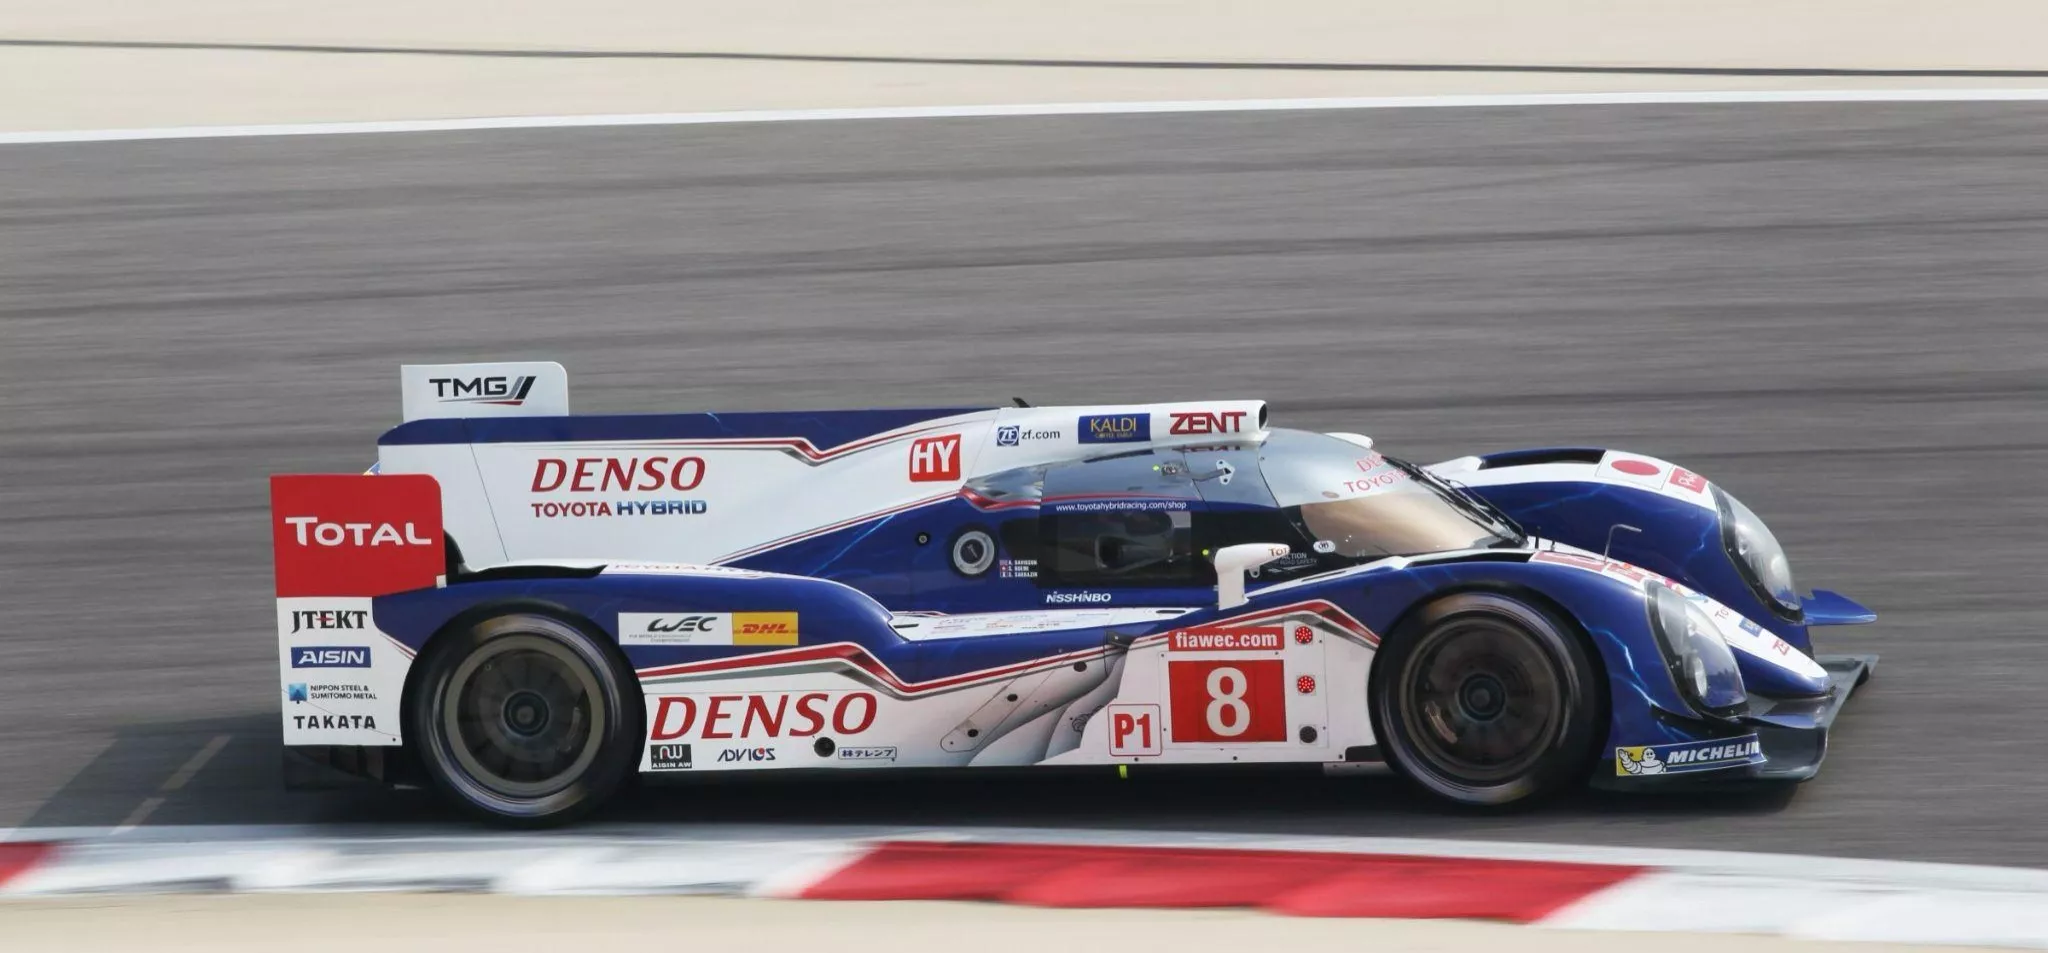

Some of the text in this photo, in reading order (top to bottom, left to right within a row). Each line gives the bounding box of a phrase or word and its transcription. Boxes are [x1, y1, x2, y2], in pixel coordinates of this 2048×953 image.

[428, 376, 508, 397] TMG
[1090, 417, 1137, 433] KALDI
[1169, 411, 1247, 435] ZENT
[1000, 429, 1018, 441] ZF
[1021, 429, 1061, 440] zf.com
[911, 439, 958, 473] HY
[531, 456, 707, 493] DENSO
[531, 499, 707, 518] TOYOTA HYBRID
[1056, 501, 1187, 512] www.toyotahybridracing.com/shop
[285, 516, 432, 547] TOTAL
[1046, 590, 1112, 603] NISSHINBO
[291, 610, 368, 634] JTEKT
[647, 615, 718, 633] WEC
[742, 623, 789, 634] DHL
[1175, 631, 1278, 648] fiawec.com
[298, 650, 365, 664] AISIN
[310, 684, 340, 692] NIPPON
[341, 684, 362, 692] STEEL
[310, 692, 352, 700] SUMITOMO
[1206, 666, 1251, 737] 8
[293, 715, 377, 730] TAKATA
[650, 692, 878, 741] DENSO
[1114, 713, 1151, 749] P1
[717, 748, 776, 762] ADVICS
[842, 749, 894, 758] 林テレンプ
[1666, 741, 1760, 764] MICHELIN
